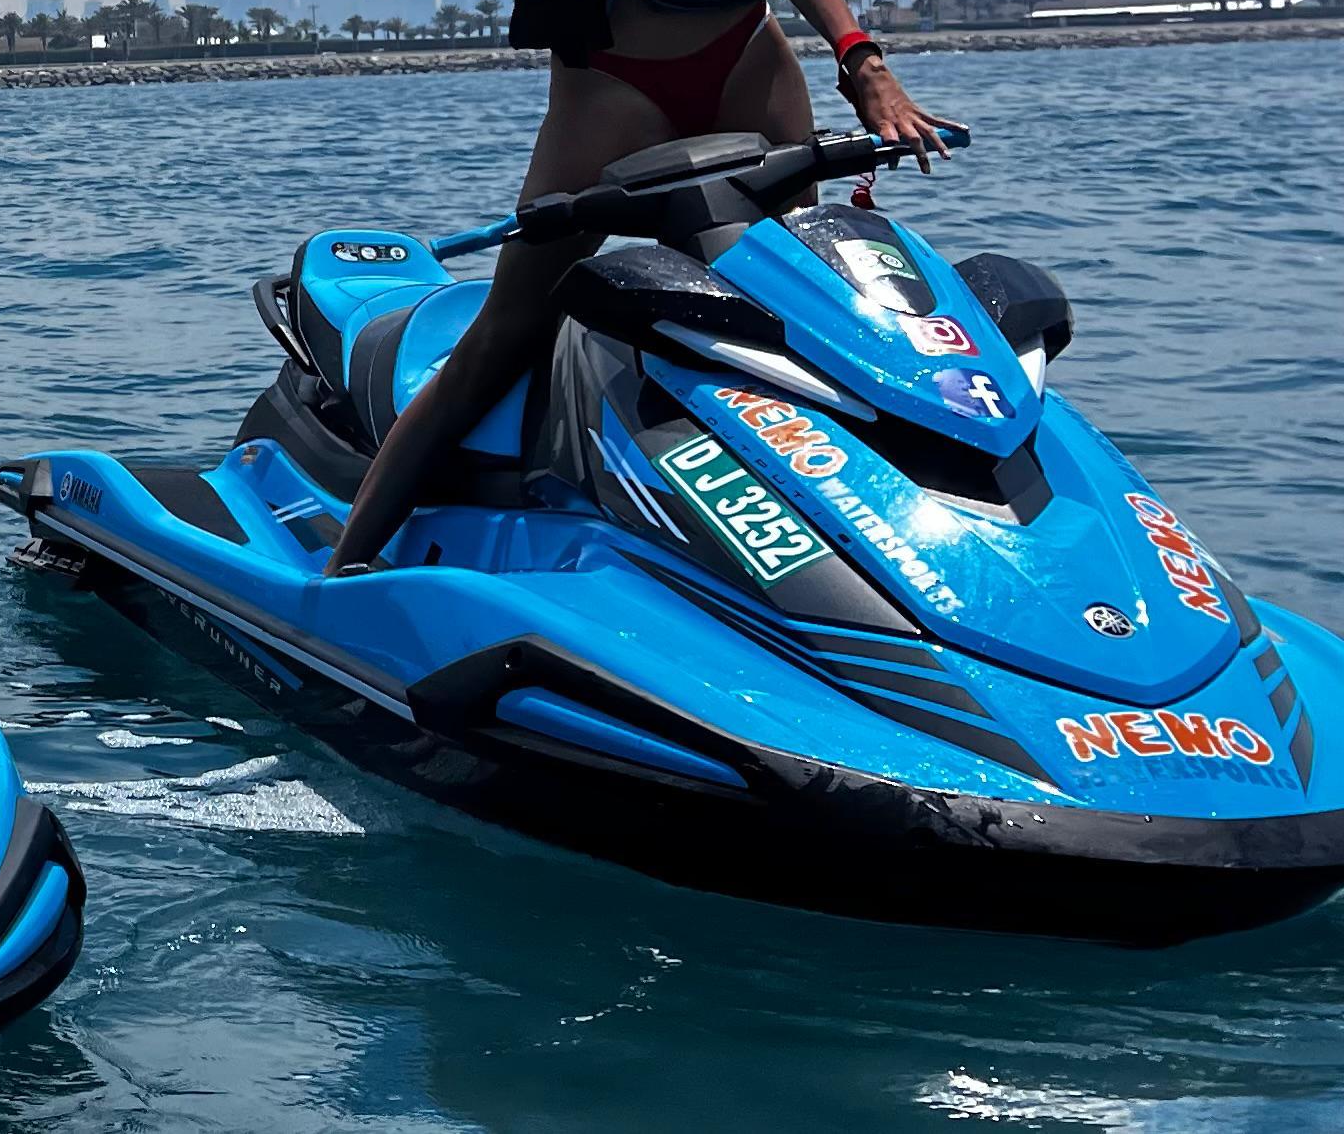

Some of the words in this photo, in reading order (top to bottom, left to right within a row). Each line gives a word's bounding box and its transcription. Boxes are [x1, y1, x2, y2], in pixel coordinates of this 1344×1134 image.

[672, 440, 723, 470] D
[714, 386, 849, 478] NEMO
[695, 468, 747, 491] J
[716, 486, 814, 569] 3252
[1124, 493, 1231, 623] NEMO
[1056, 709, 1273, 764] NEMO
